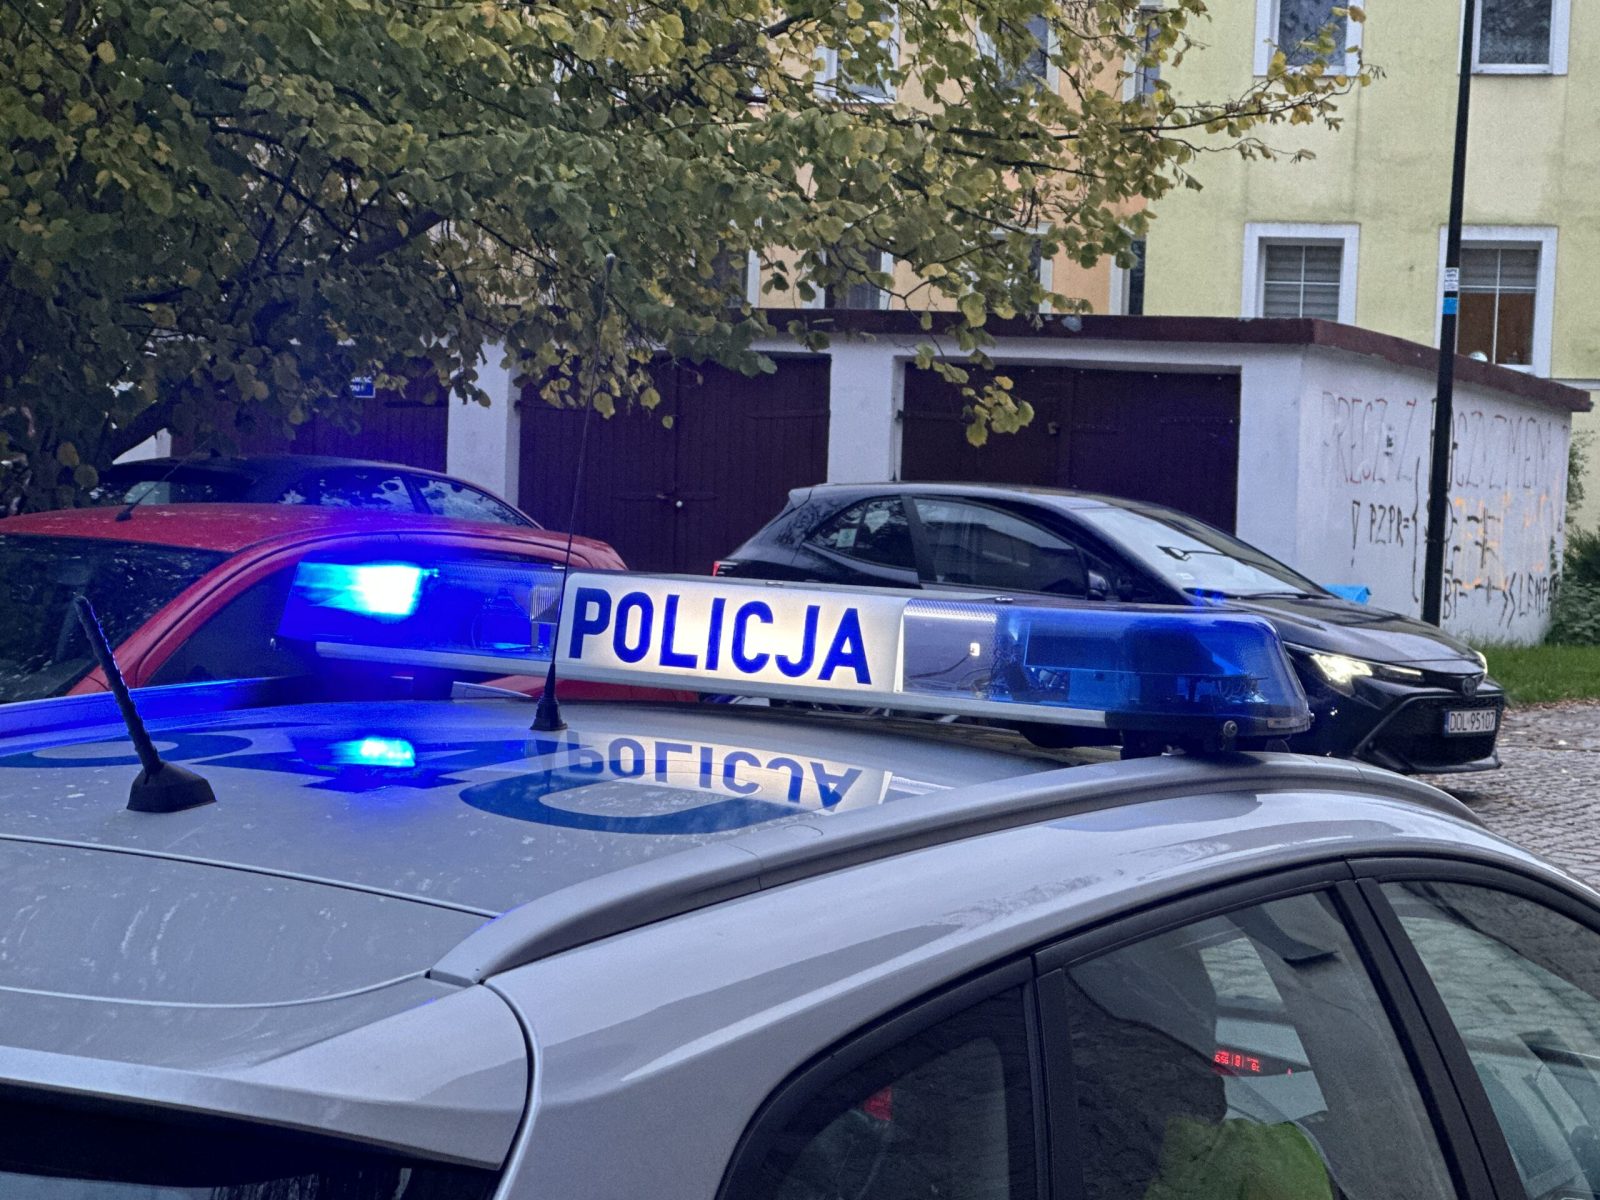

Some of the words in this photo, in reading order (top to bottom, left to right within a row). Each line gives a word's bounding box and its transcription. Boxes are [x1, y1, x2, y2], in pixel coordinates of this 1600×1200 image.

[568, 587, 872, 685] POLICJA
[1449, 713, 1467, 731] DOL
[1470, 711, 1495, 730] 95107
